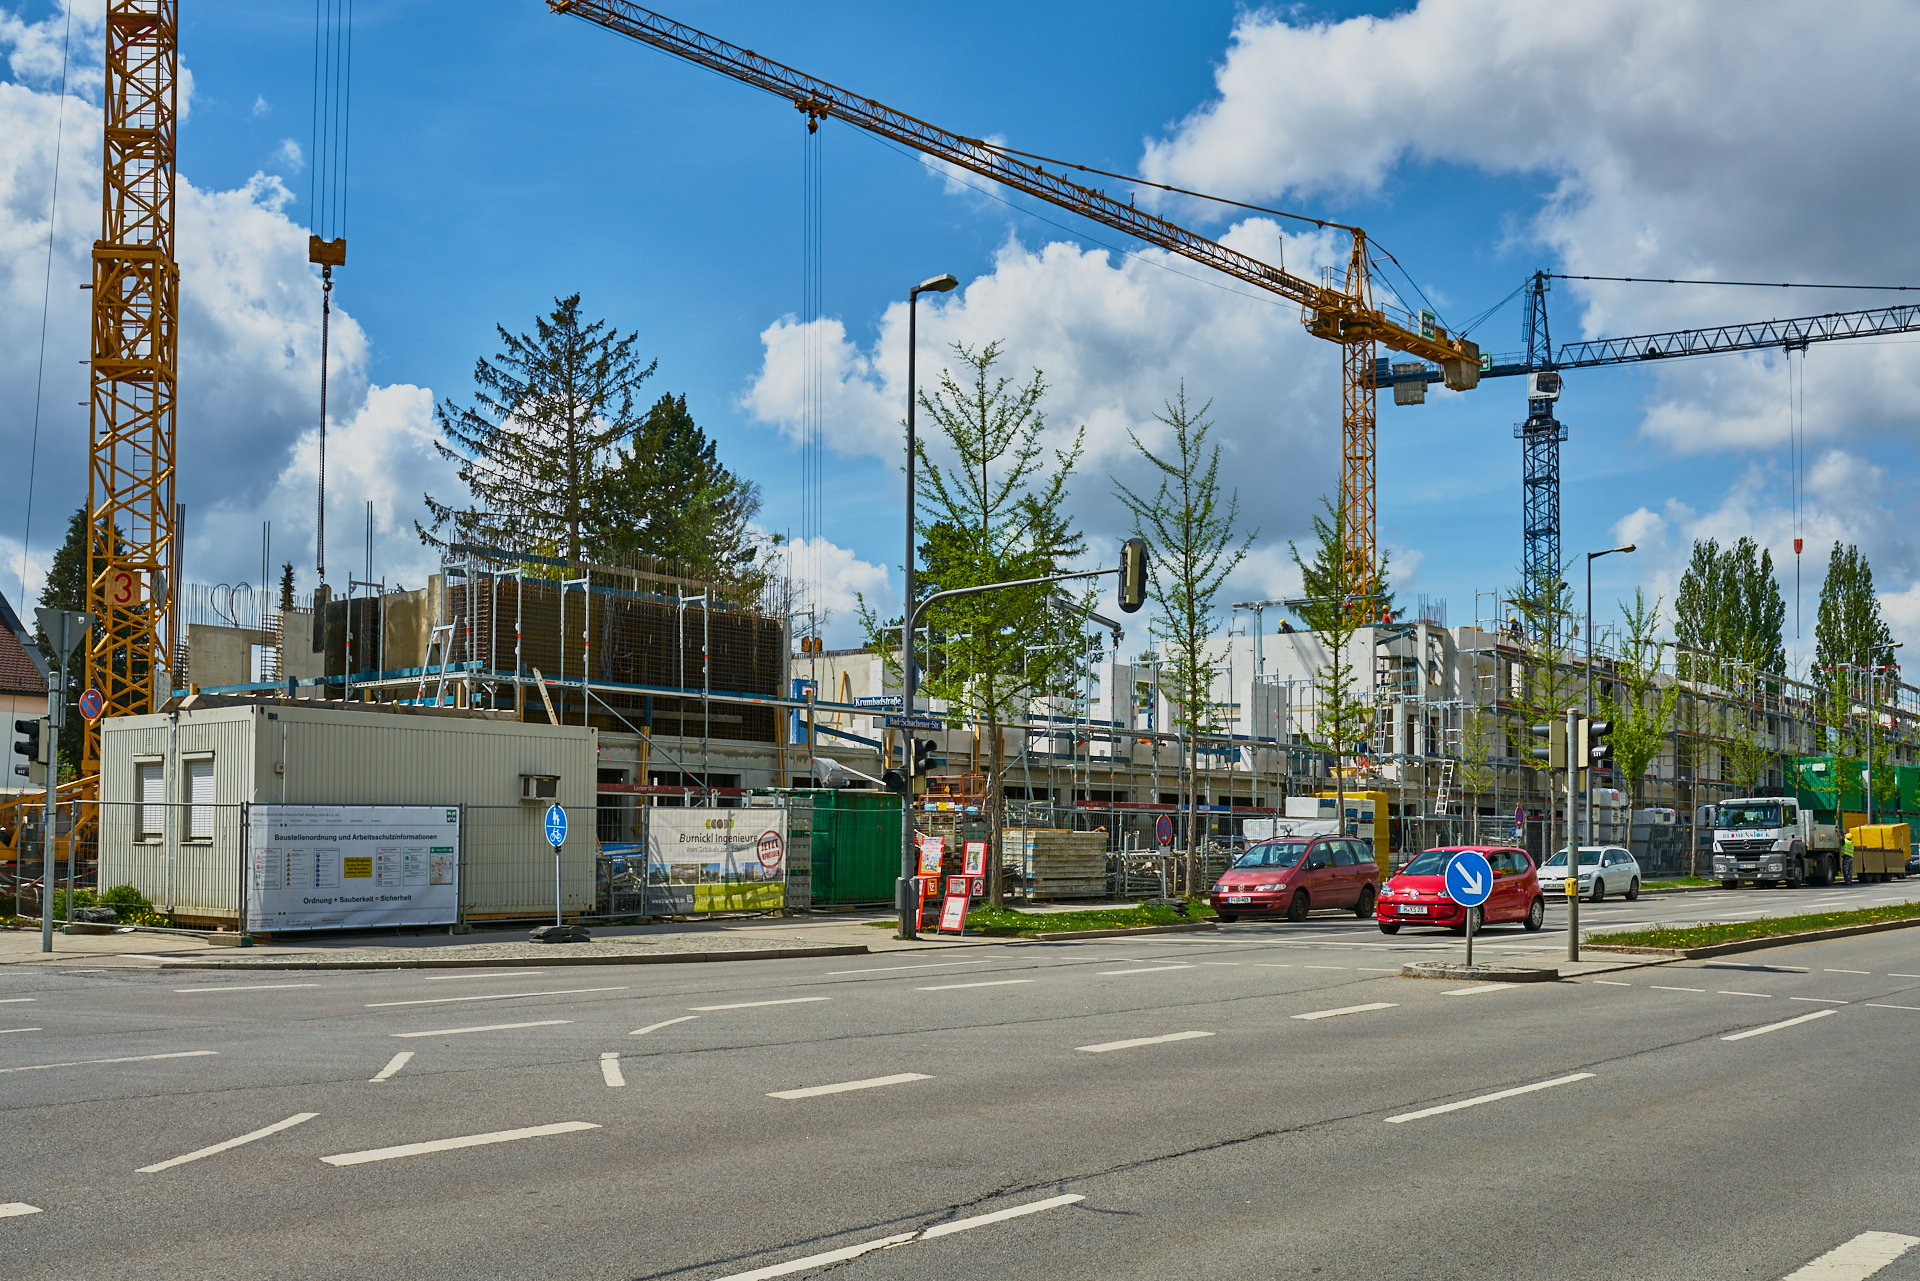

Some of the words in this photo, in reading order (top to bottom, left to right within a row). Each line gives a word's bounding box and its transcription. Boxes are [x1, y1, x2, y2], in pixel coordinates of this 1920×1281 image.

[113, 573, 132, 603] 3
[855, 697, 902, 706] Krumbadstraße
[274, 833, 337, 842] Baustellenordnung
[352, 833, 438, 841] Arbeitsschutzinformationen
[679, 832, 714, 843] Burnickl
[715, 832, 758, 846] Ingenieure
[761, 838, 779, 852] JETZT
[303, 897, 332, 905] Ordnung
[339, 895, 374, 903] Sauberkeit
[380, 894, 412, 902] Sicherheit
[697, 893, 727, 902] Technische
